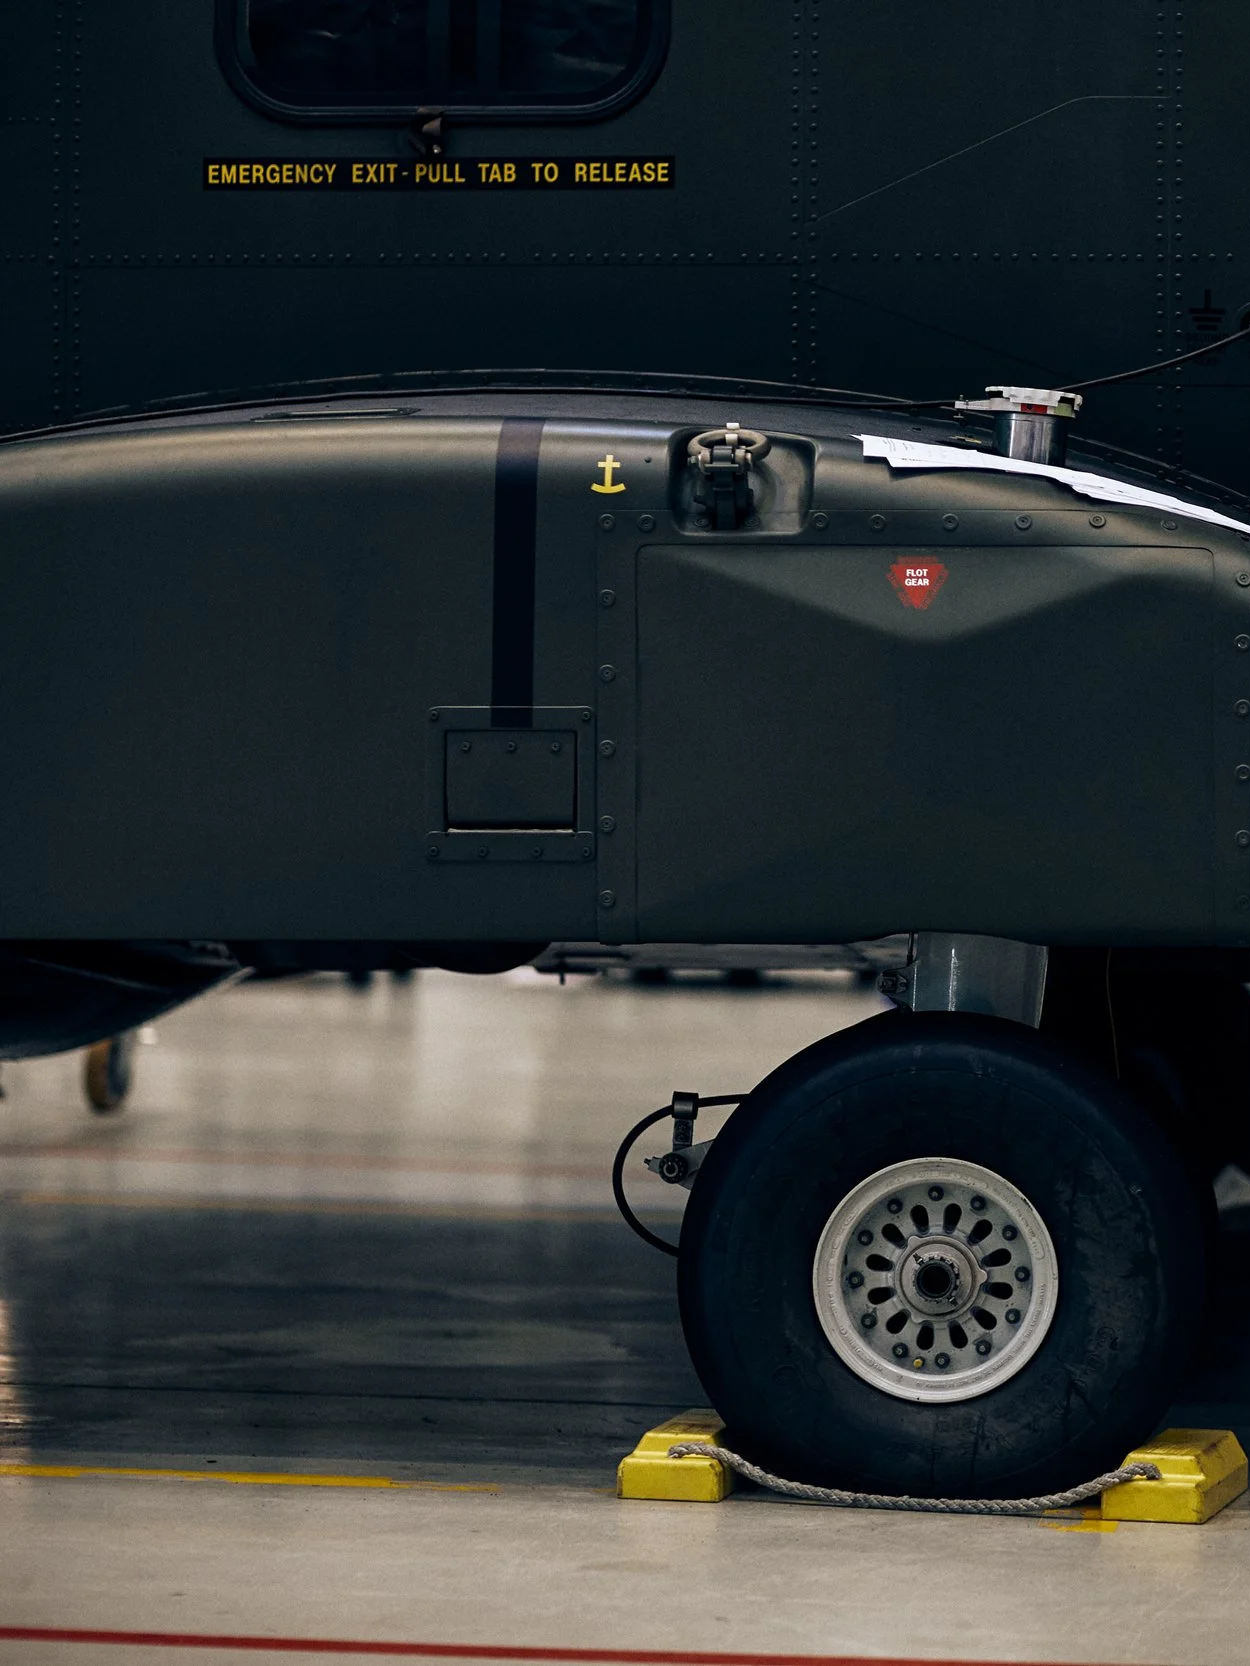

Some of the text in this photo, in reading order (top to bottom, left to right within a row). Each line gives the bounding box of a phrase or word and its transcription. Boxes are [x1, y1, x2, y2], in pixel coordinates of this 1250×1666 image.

[207, 163, 336, 185] EMERGENCY
[351, 163, 399, 184] EXIT
[415, 163, 466, 184] PULL
[478, 162, 517, 183] TAB
[531, 162, 559, 183] TO
[574, 161, 669, 183] RELEASE
[905, 568, 929, 578] FLOT
[904, 578, 930, 587] GEAR
